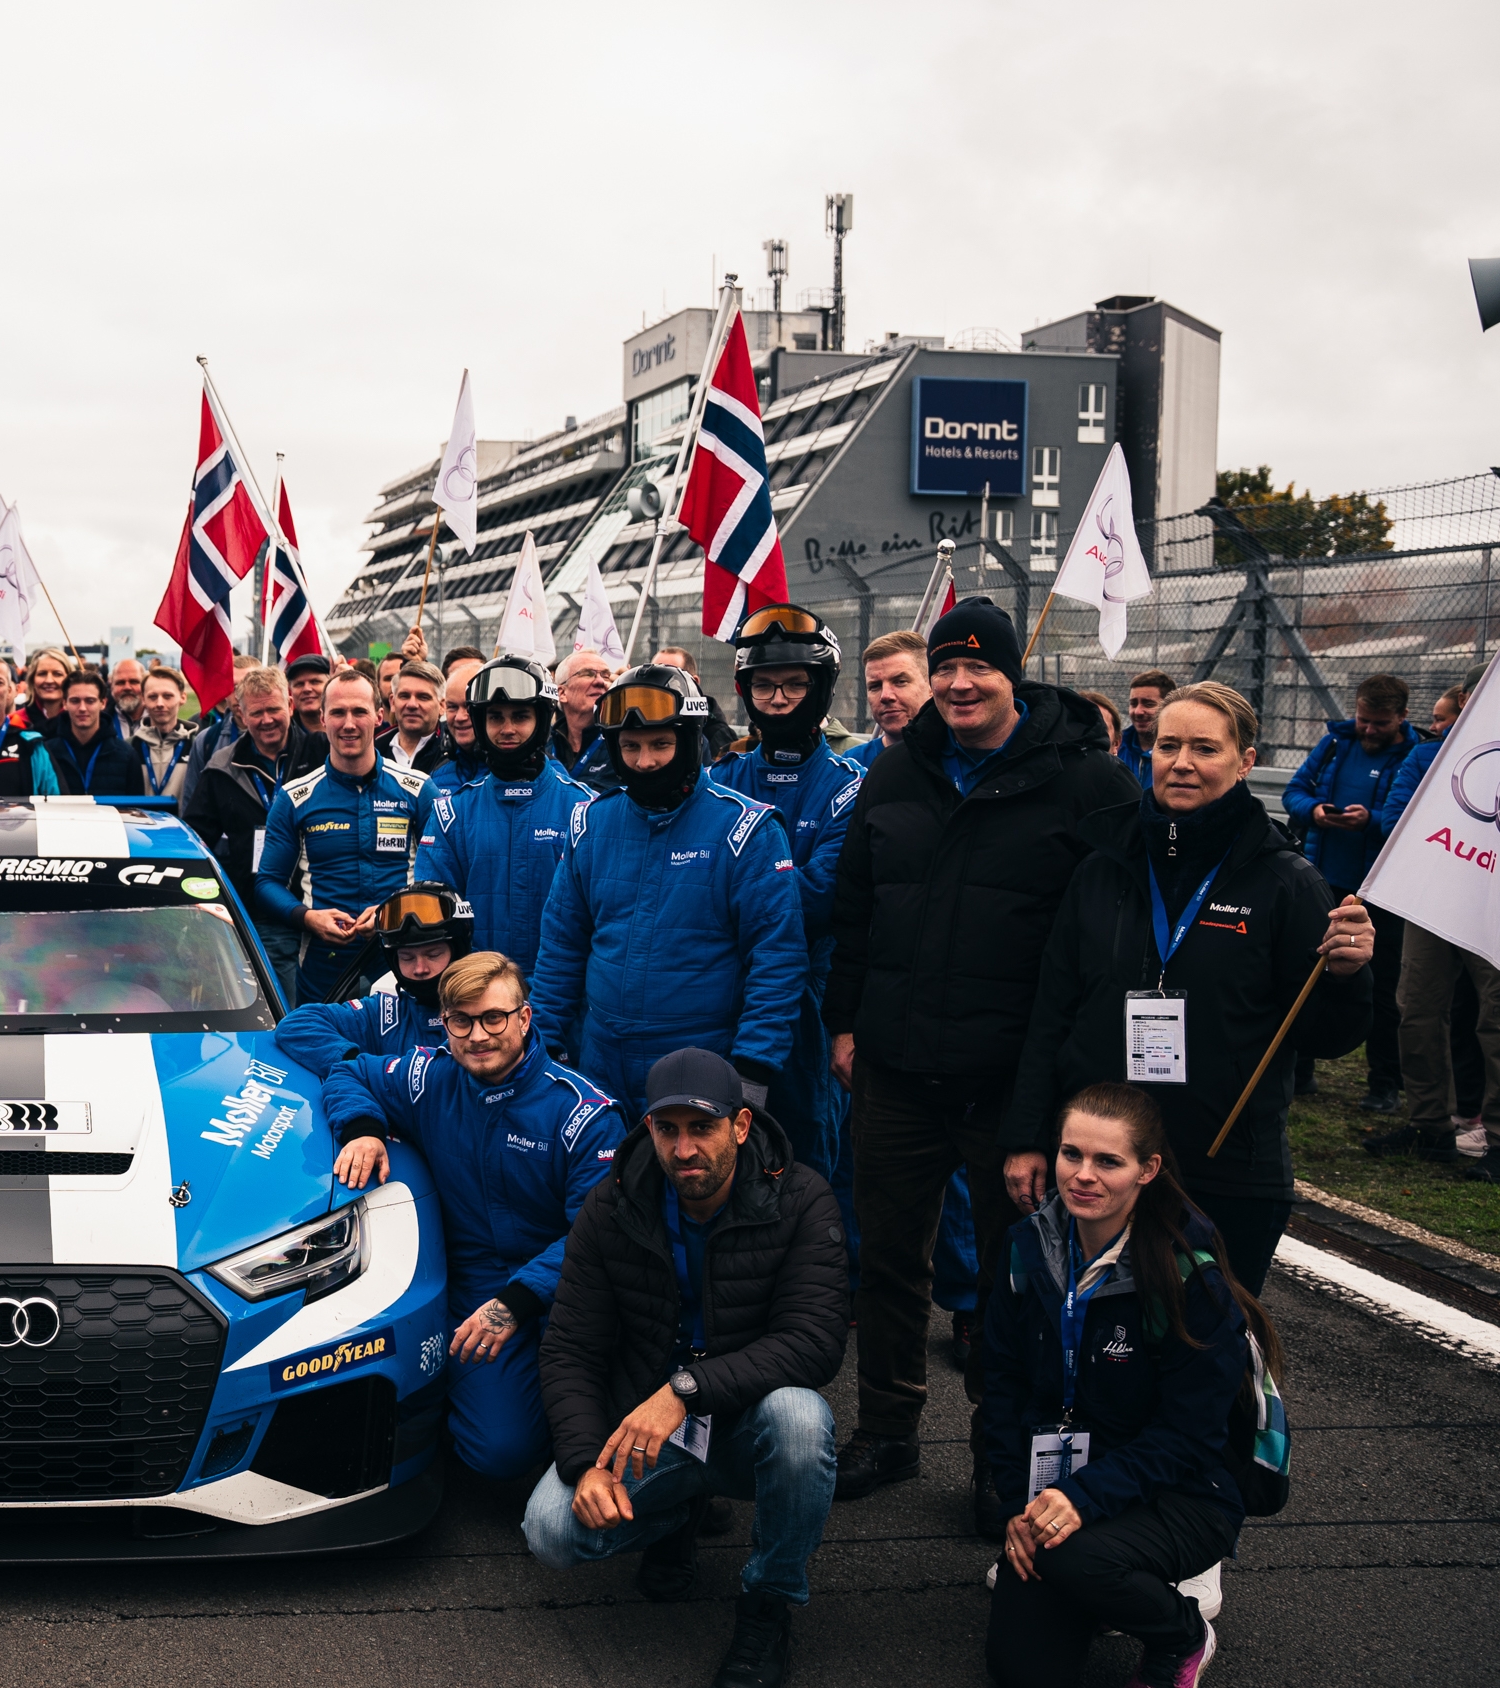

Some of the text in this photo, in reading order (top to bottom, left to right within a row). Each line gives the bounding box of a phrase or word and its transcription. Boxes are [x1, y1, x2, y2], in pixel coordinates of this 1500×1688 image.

[632, 332, 675, 377] Dorint
[924, 417, 1018, 441] Dorint
[925, 445, 1019, 460] Hotels & Resorts
[882, 533, 922, 552] ein
[929, 510, 981, 543] Bit
[518, 607, 534, 620] Au
[402, 777, 420, 789] OMP
[767, 774, 798, 782] sparco
[292, 787, 310, 801] OMP
[504, 788, 532, 796] sparco
[373, 800, 398, 808] Moller
[534, 828, 559, 837] Moller
[732, 811, 758, 843] sparco
[671, 850, 710, 861] Moller Bil
[1425, 827, 1497, 873] Audi
[5, 874, 89, 883] SIMULATOR
[1209, 903, 1251, 915] Moller Bil
[385, 996, 393, 1024] sparco
[428, 1018, 442, 1027] spa
[412, 1056, 426, 1092] sparco
[200, 1058, 288, 1147] Moller Bil
[485, 1088, 514, 1104] sparco
[564, 1104, 594, 1139] sparco
[251, 1105, 298, 1160] Motorsport
[507, 1133, 548, 1151] Moller Bil
[282, 1337, 386, 1382] GOODYEAR
